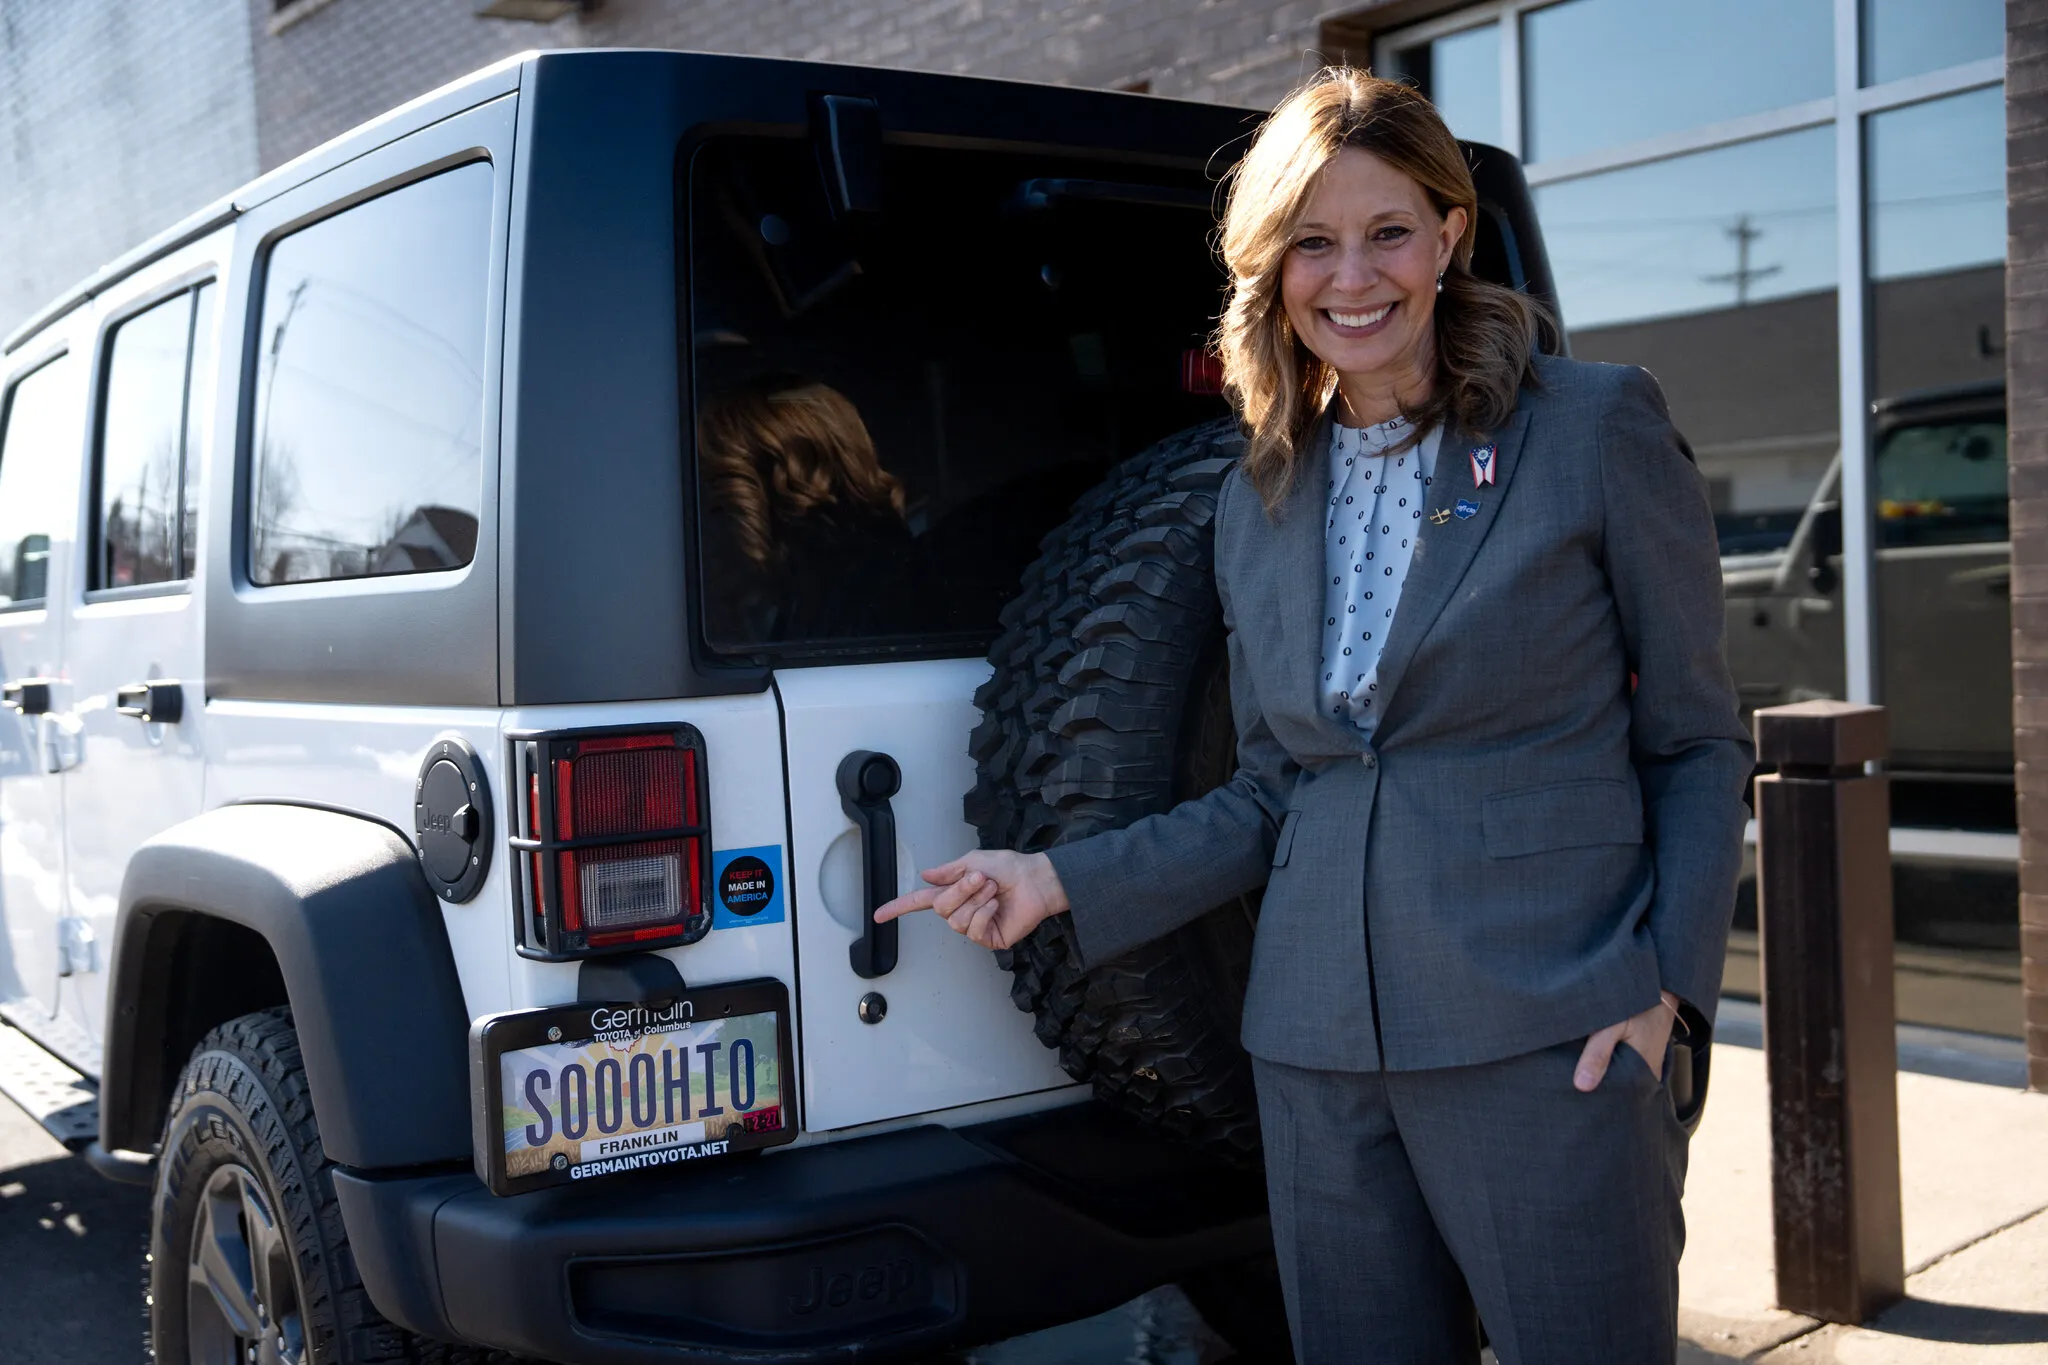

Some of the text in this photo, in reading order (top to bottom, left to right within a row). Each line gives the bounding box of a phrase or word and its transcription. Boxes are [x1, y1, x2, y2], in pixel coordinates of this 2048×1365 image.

[423, 807, 451, 835] Jeep
[728, 880, 766, 892] MADE IN
[729, 869, 763, 880] KEEP IT
[727, 891, 769, 904] AMERICA
[591, 1000, 693, 1031] Germain
[593, 1029, 631, 1043] TOYOTA
[643, 1021, 692, 1035] Columbus
[524, 1038, 755, 1148] SOOOHIO
[599, 1130, 679, 1155] FRANKLIN
[570, 1140, 730, 1180] GERMAINTOYOTA.NET
[787, 1256, 914, 1314] Jeep
